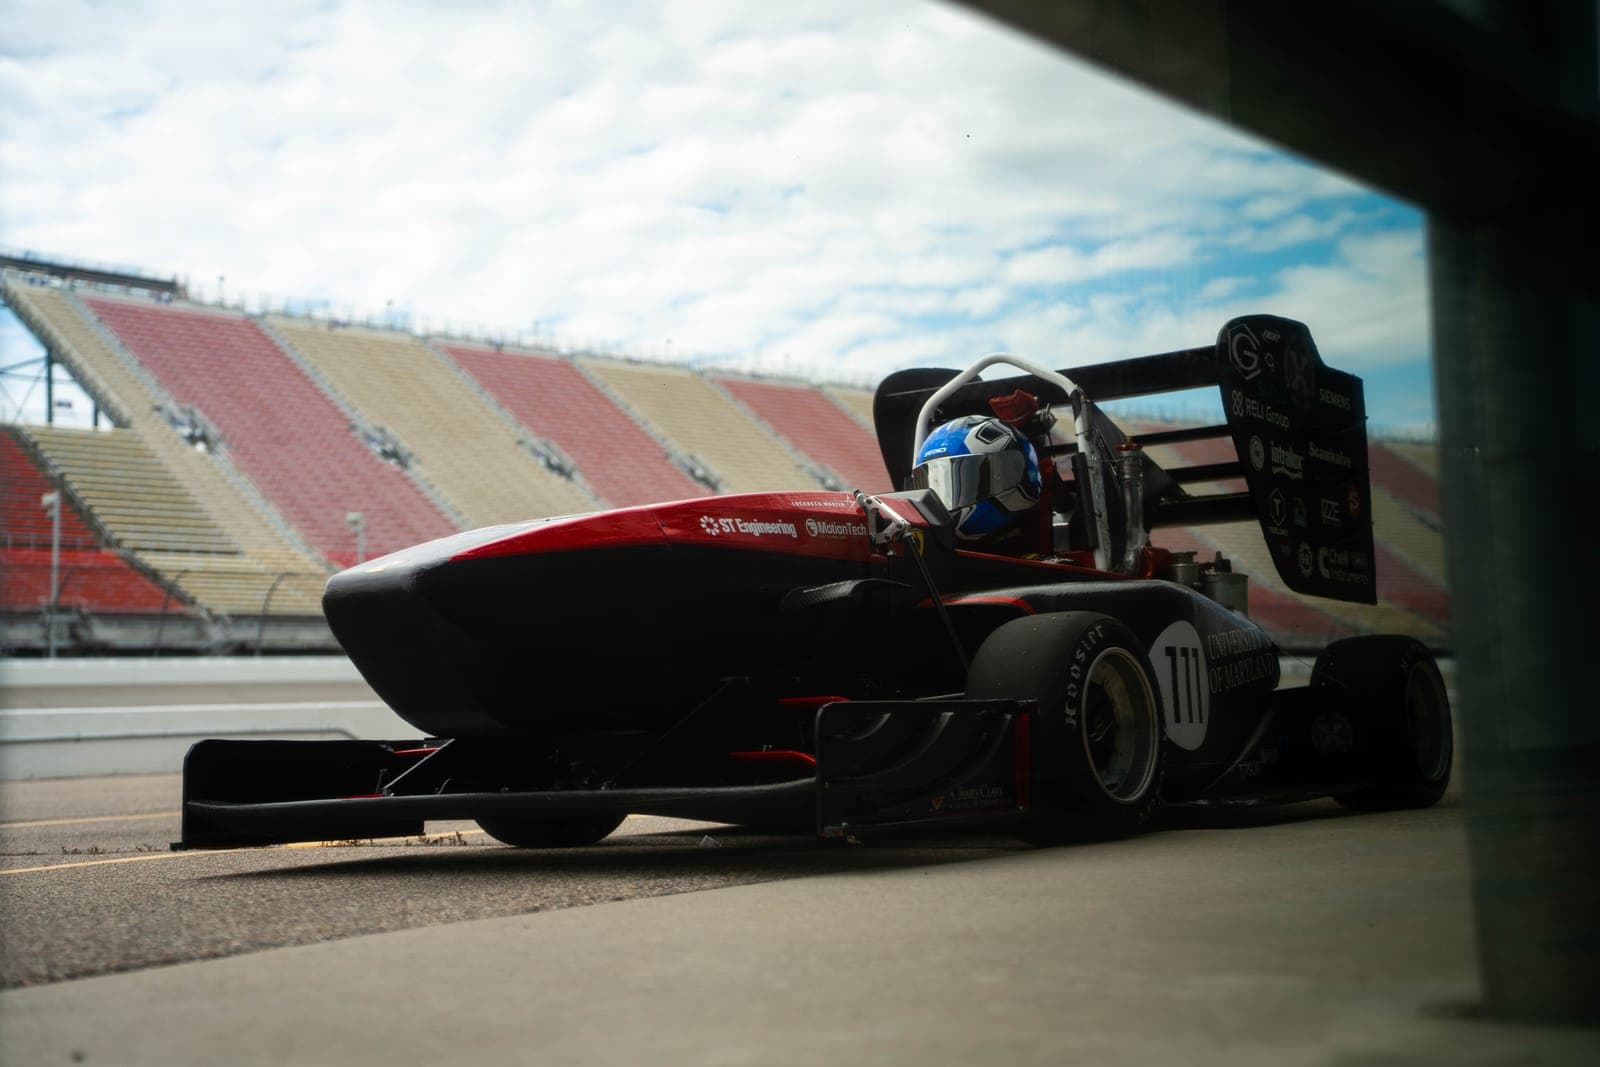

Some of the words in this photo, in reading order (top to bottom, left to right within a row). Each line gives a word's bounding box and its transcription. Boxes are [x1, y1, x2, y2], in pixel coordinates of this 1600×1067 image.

[1266, 406, 1290, 432] Group
[718, 519, 733, 533] ST
[735, 519, 798, 538] Engineering
[817, 521, 867, 537] MotionTech
[1165, 646, 1203, 724] 111
